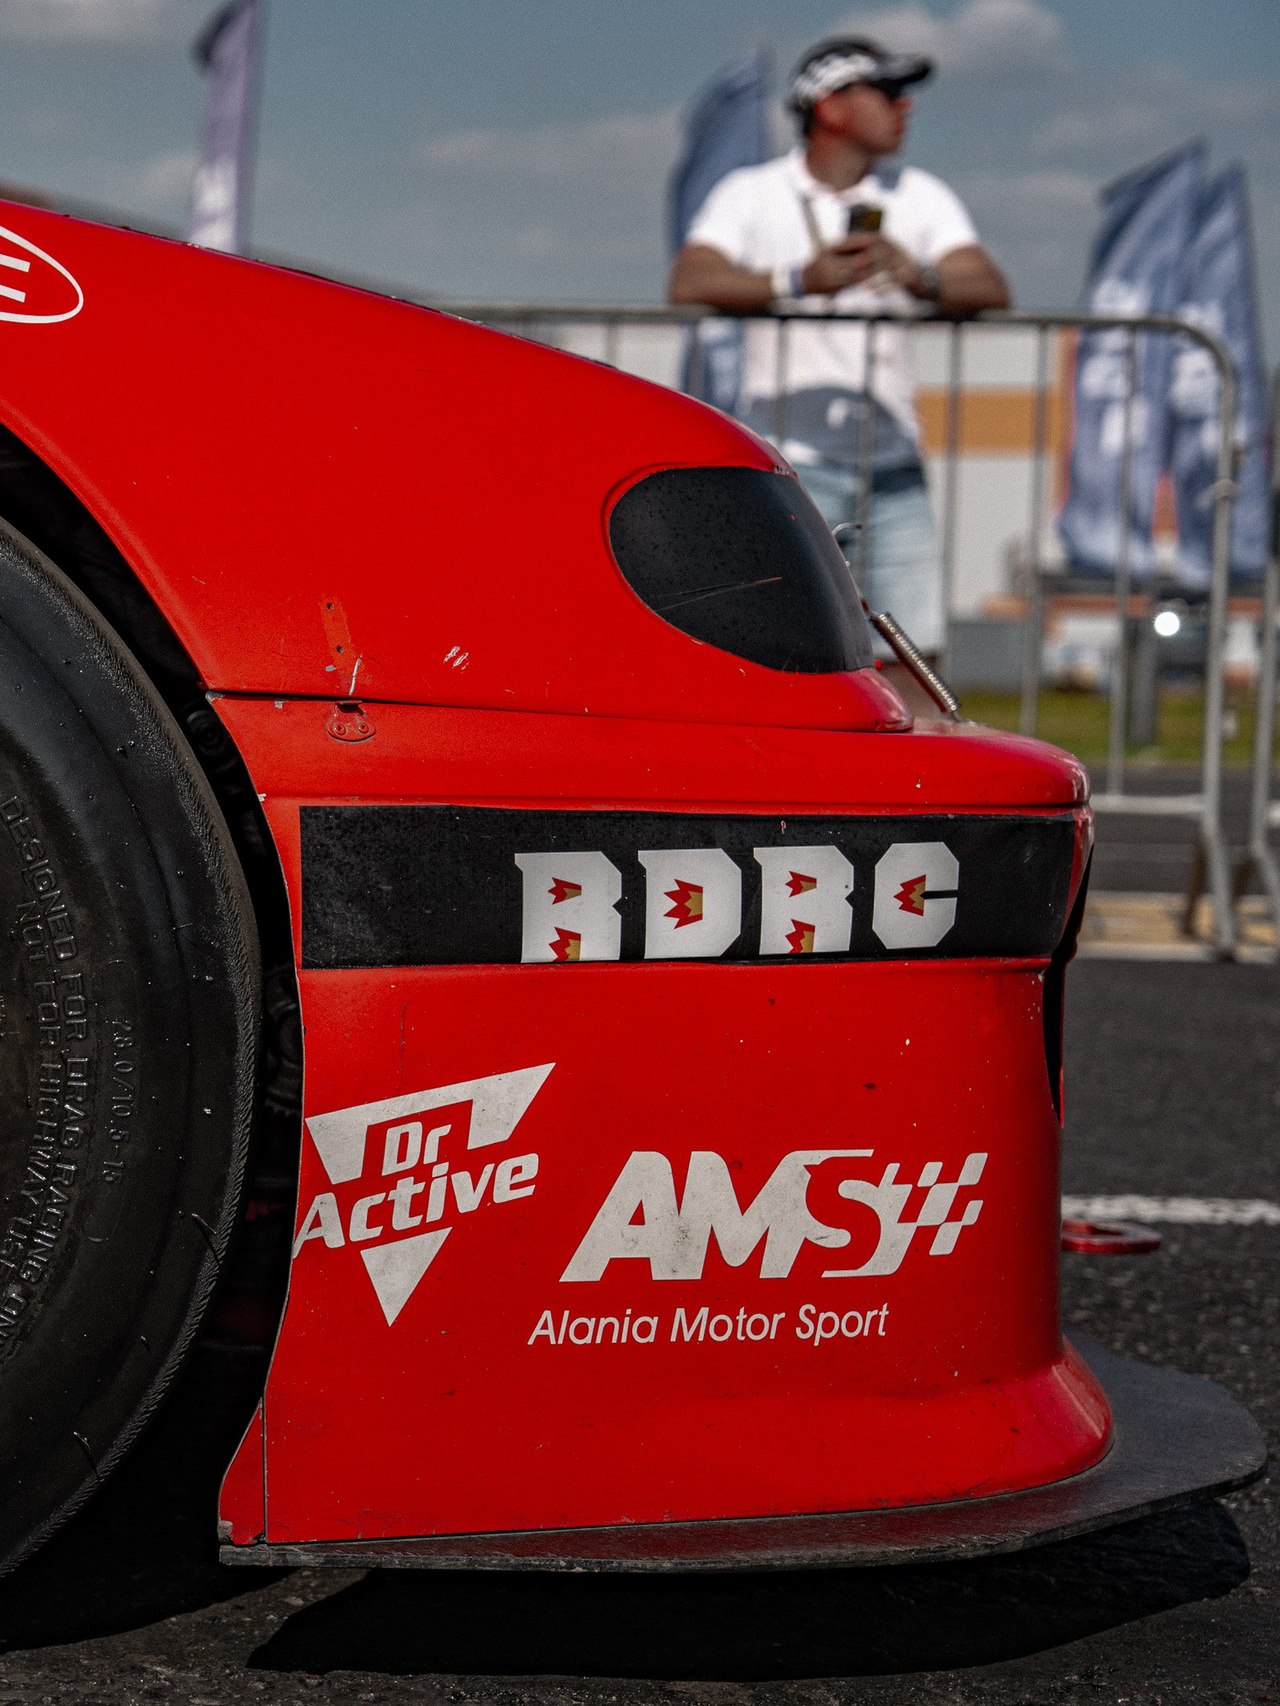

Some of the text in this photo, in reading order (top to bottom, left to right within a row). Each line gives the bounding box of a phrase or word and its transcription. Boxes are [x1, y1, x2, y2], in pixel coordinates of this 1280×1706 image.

[15, 899, 52, 965] NOT
[513, 841, 961, 964] RDRC
[34, 980, 61, 1047] FOR
[60, 972, 87, 1040] FOR
[19, 1063, 62, 1206] HIGHWAY
[60, 1057, 89, 1150] DRAG
[381, 1119, 452, 1177] Dr
[19, 1162, 78, 1285] RACING
[292, 1152, 540, 1259] Active
[527, 1302, 889, 1346] Alania Motor Sport
